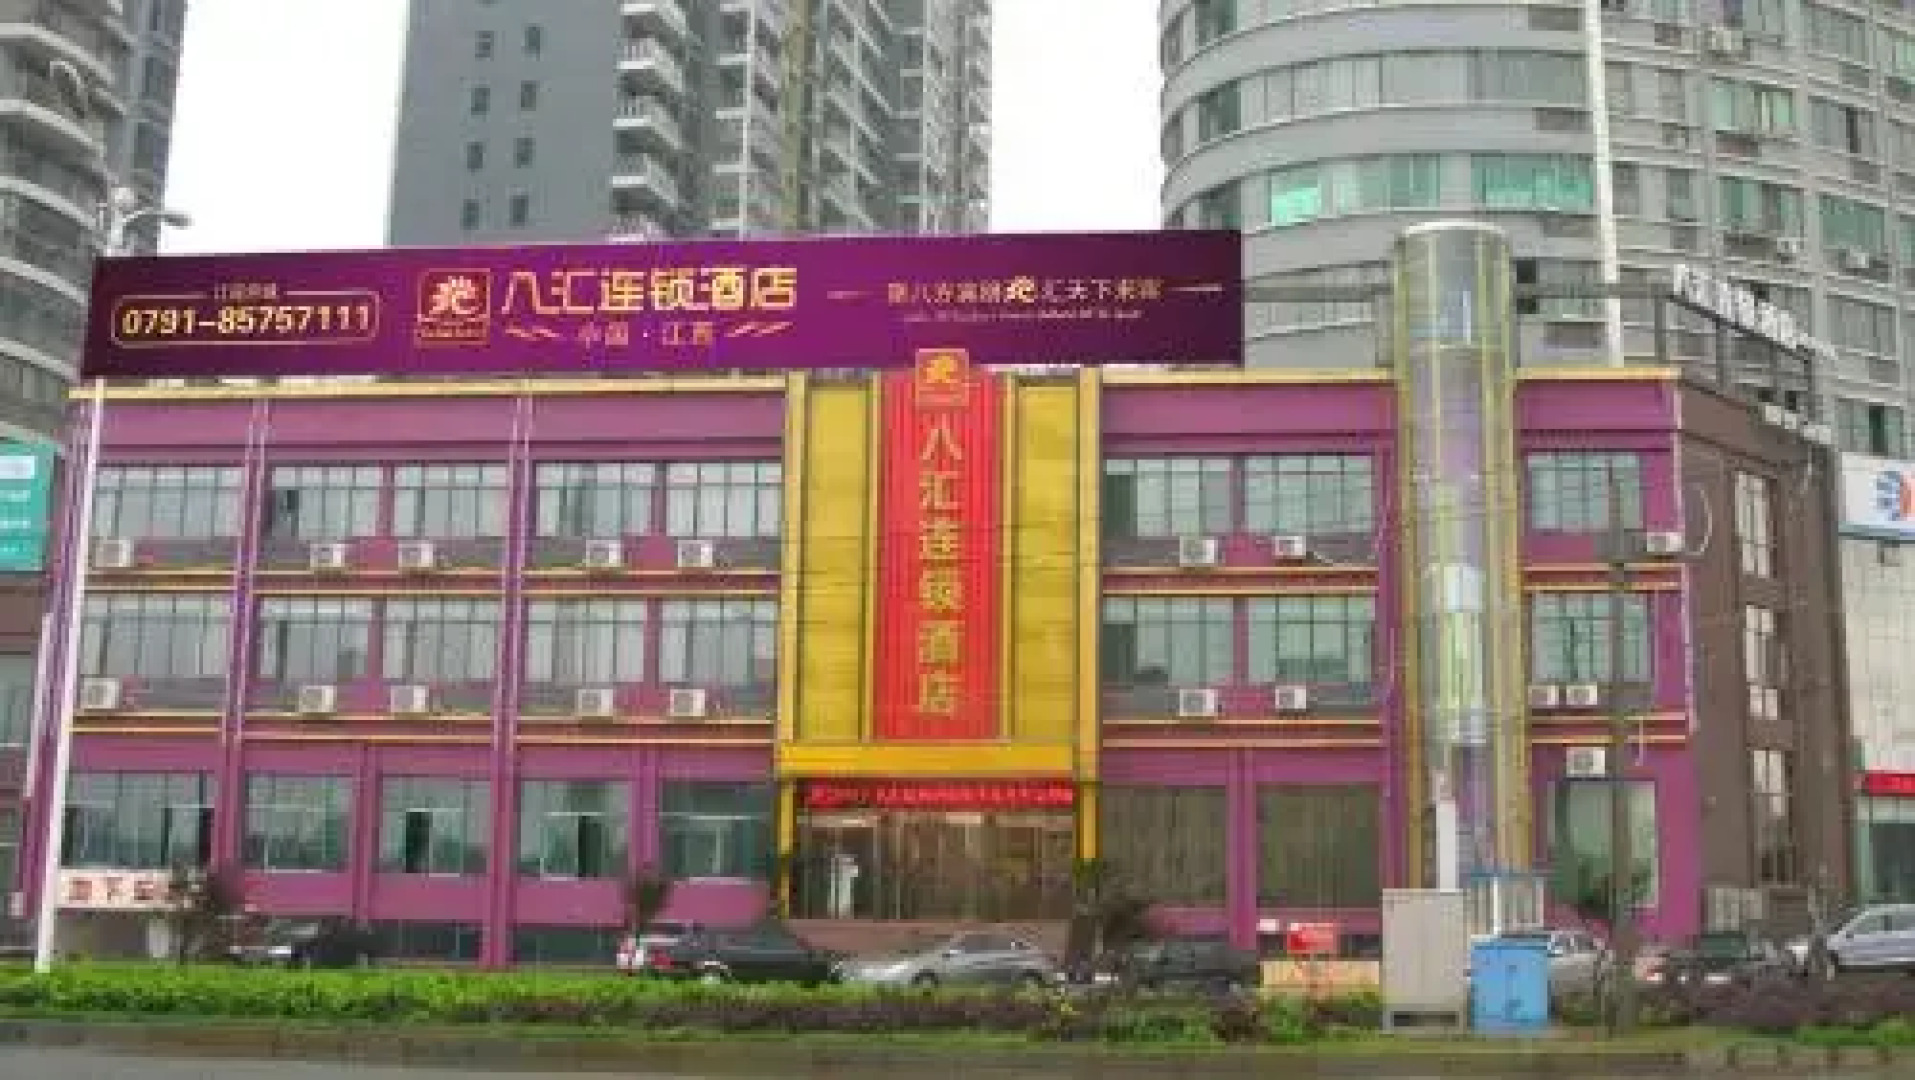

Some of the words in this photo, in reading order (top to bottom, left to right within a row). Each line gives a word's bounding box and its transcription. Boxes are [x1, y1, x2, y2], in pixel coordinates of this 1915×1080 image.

[501, 266, 798, 315] 八汇连锁酒店
[121, 304, 370, 335] 0791-85757111
[918, 413, 966, 720] 八汇连锁酒店
